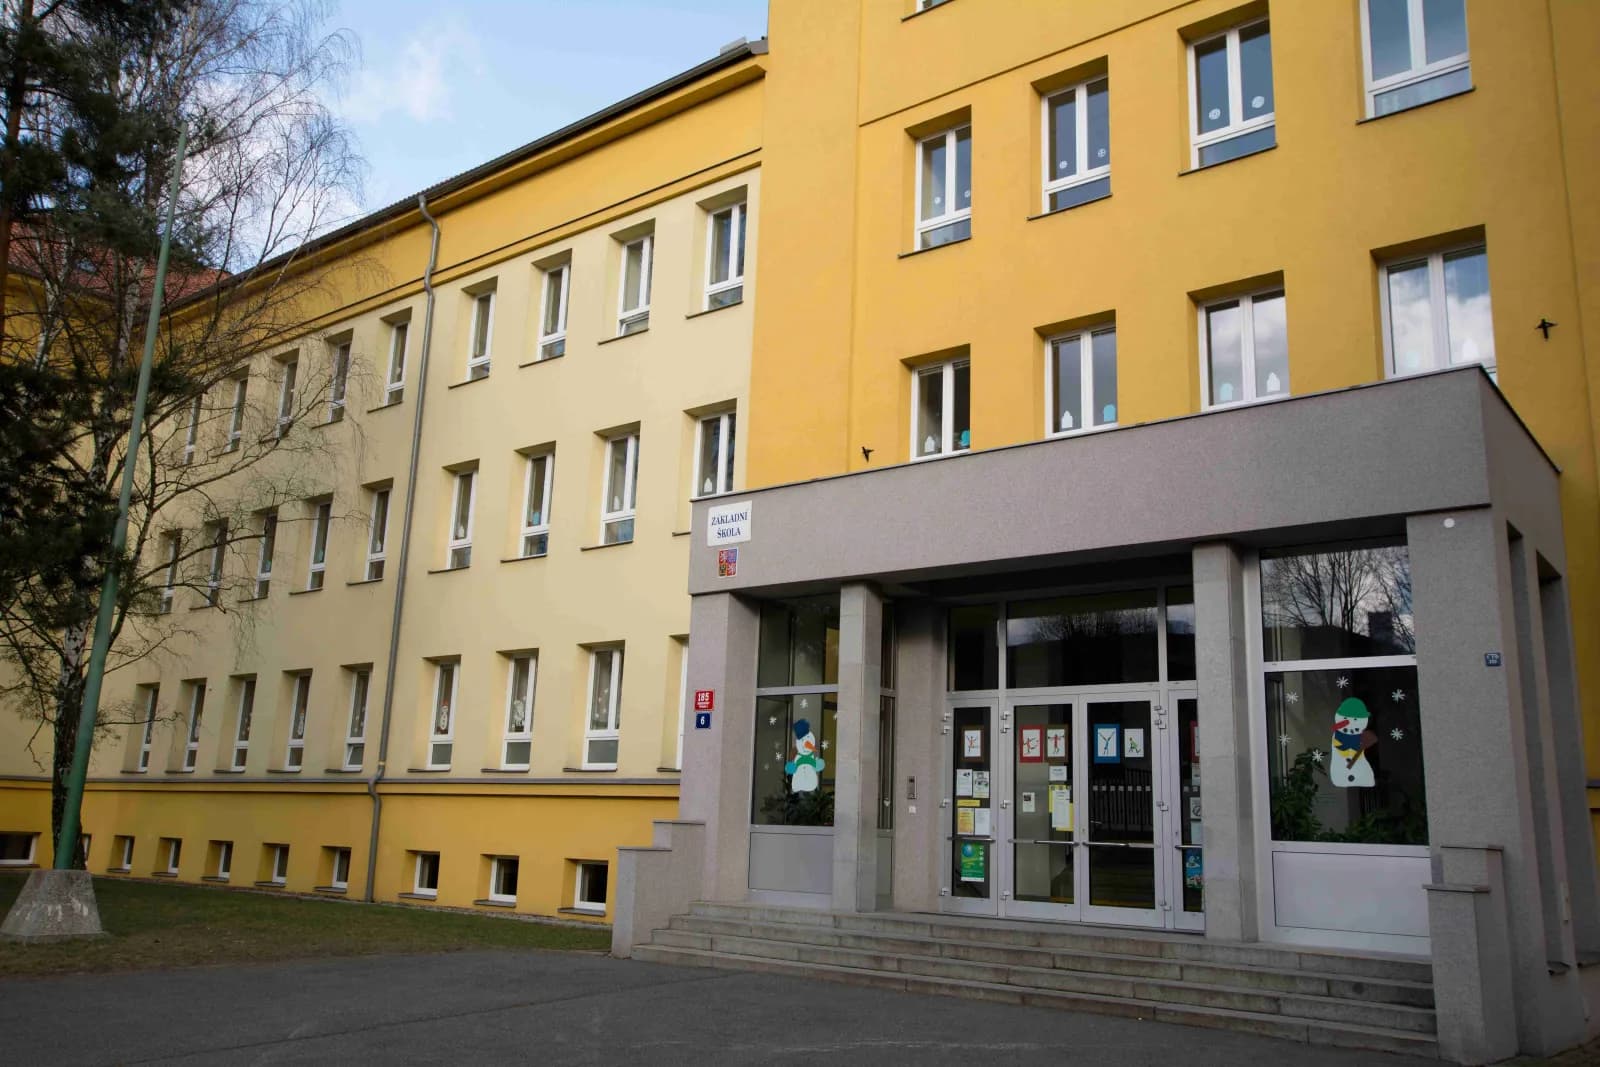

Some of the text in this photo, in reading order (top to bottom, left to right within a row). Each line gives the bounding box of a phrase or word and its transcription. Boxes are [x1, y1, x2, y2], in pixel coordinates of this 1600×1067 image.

[711, 510, 748, 526] ZÁKLADNÍ
[717, 527, 741, 539] ŠKOLA
[698, 692, 710, 702] 185
[700, 716, 705, 726] 6
